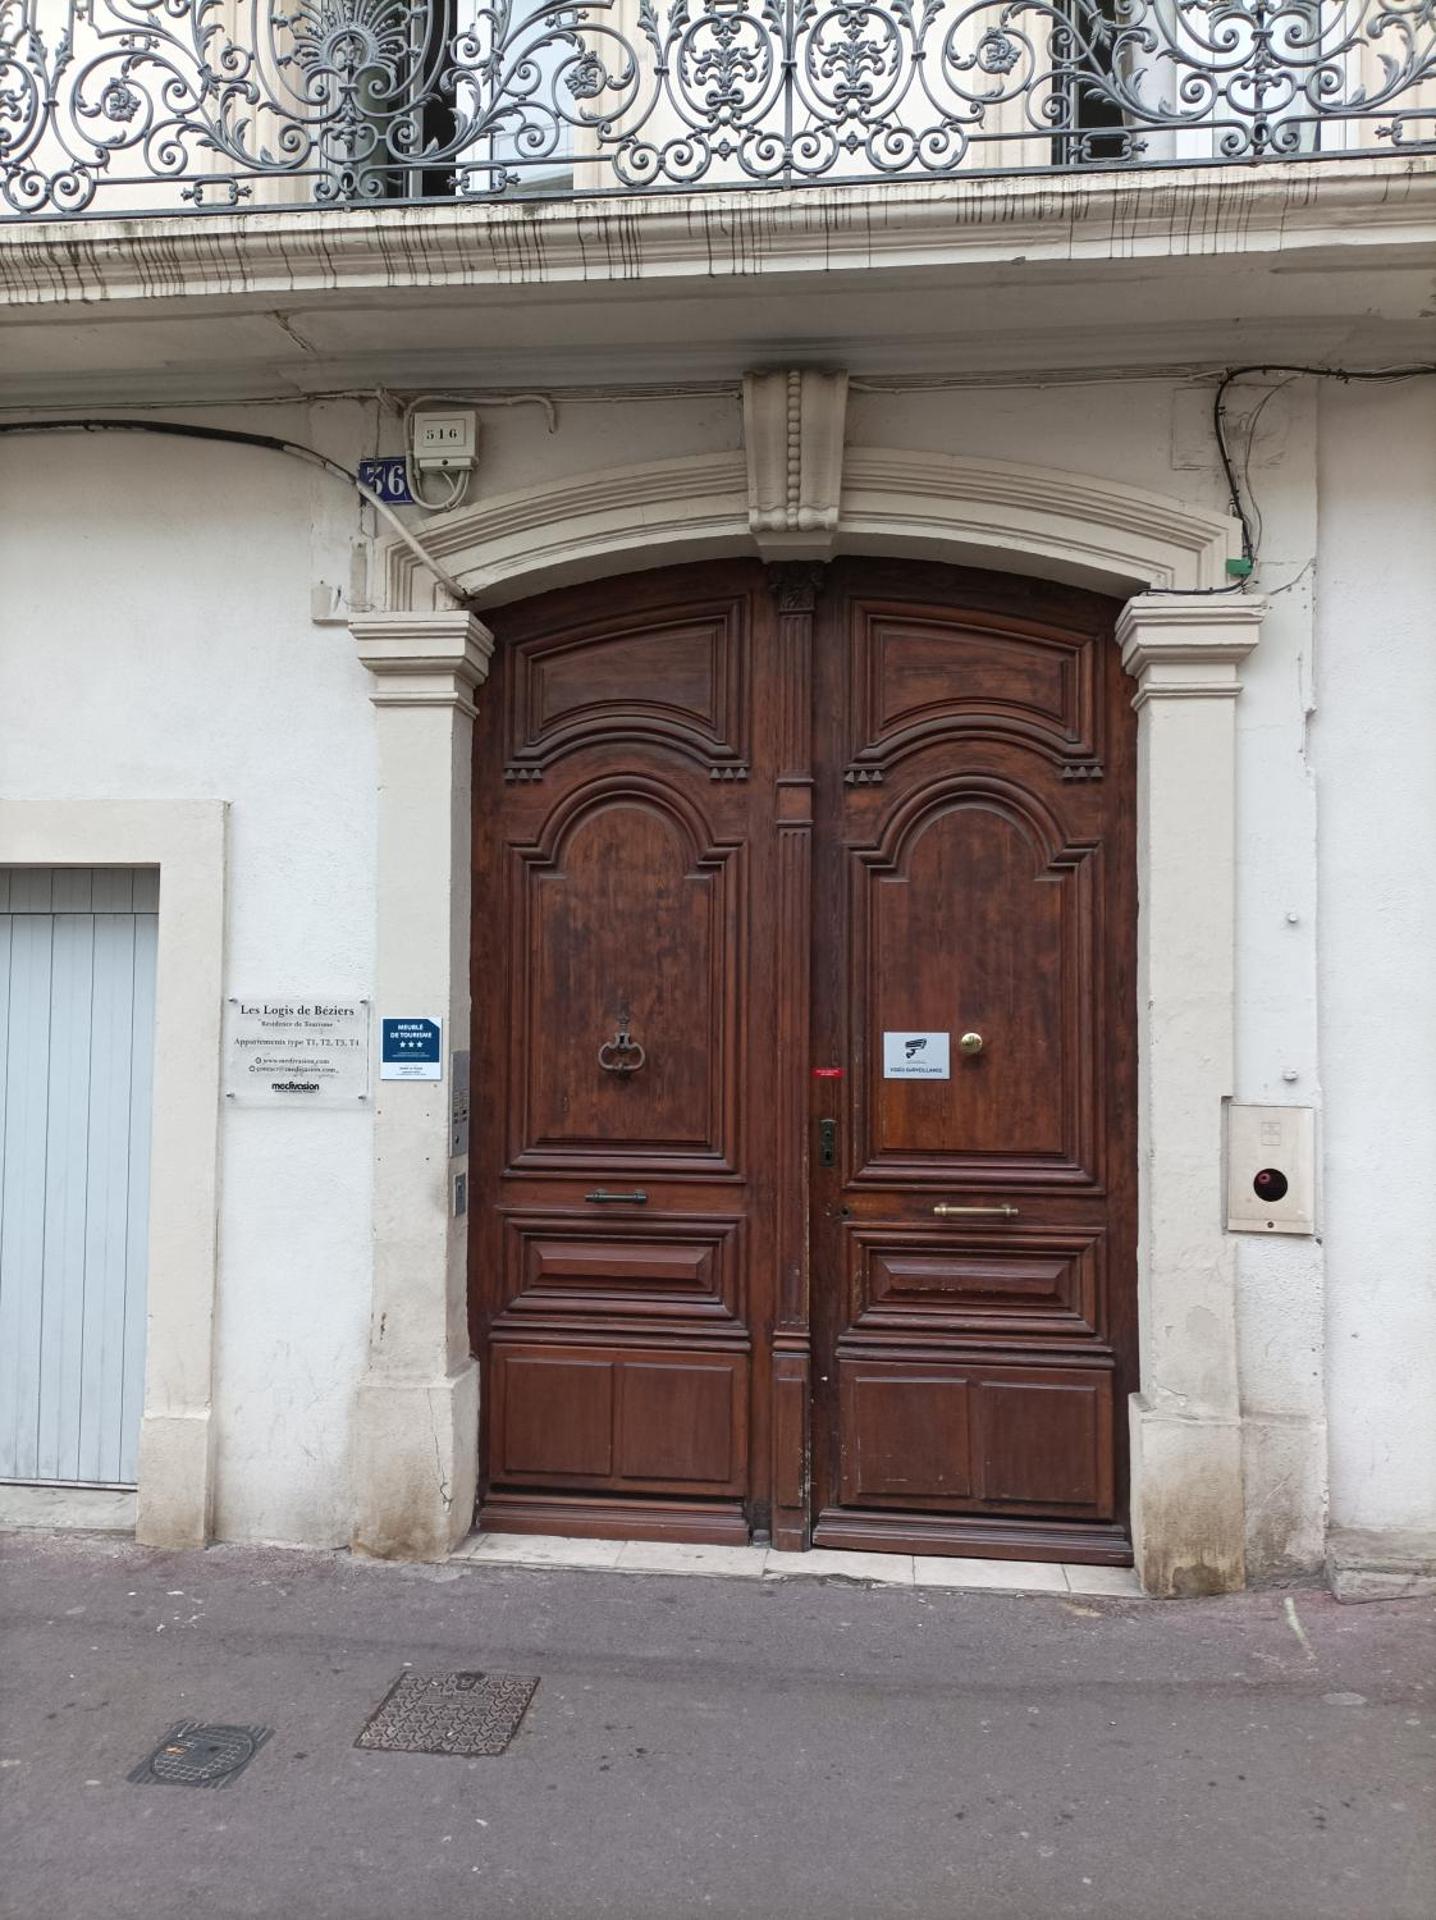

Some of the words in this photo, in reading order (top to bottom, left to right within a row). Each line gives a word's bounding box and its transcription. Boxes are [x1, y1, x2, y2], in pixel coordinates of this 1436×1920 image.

[426, 428, 457, 440] 516
[366, 465, 405, 495] 36
[241, 1004, 260, 1015] Les
[264, 1004, 294, 1017] Logis
[297, 1004, 311, 1015] de
[314, 1005, 355, 1016] Béziers
[271, 1081, 320, 1091] medivasion
